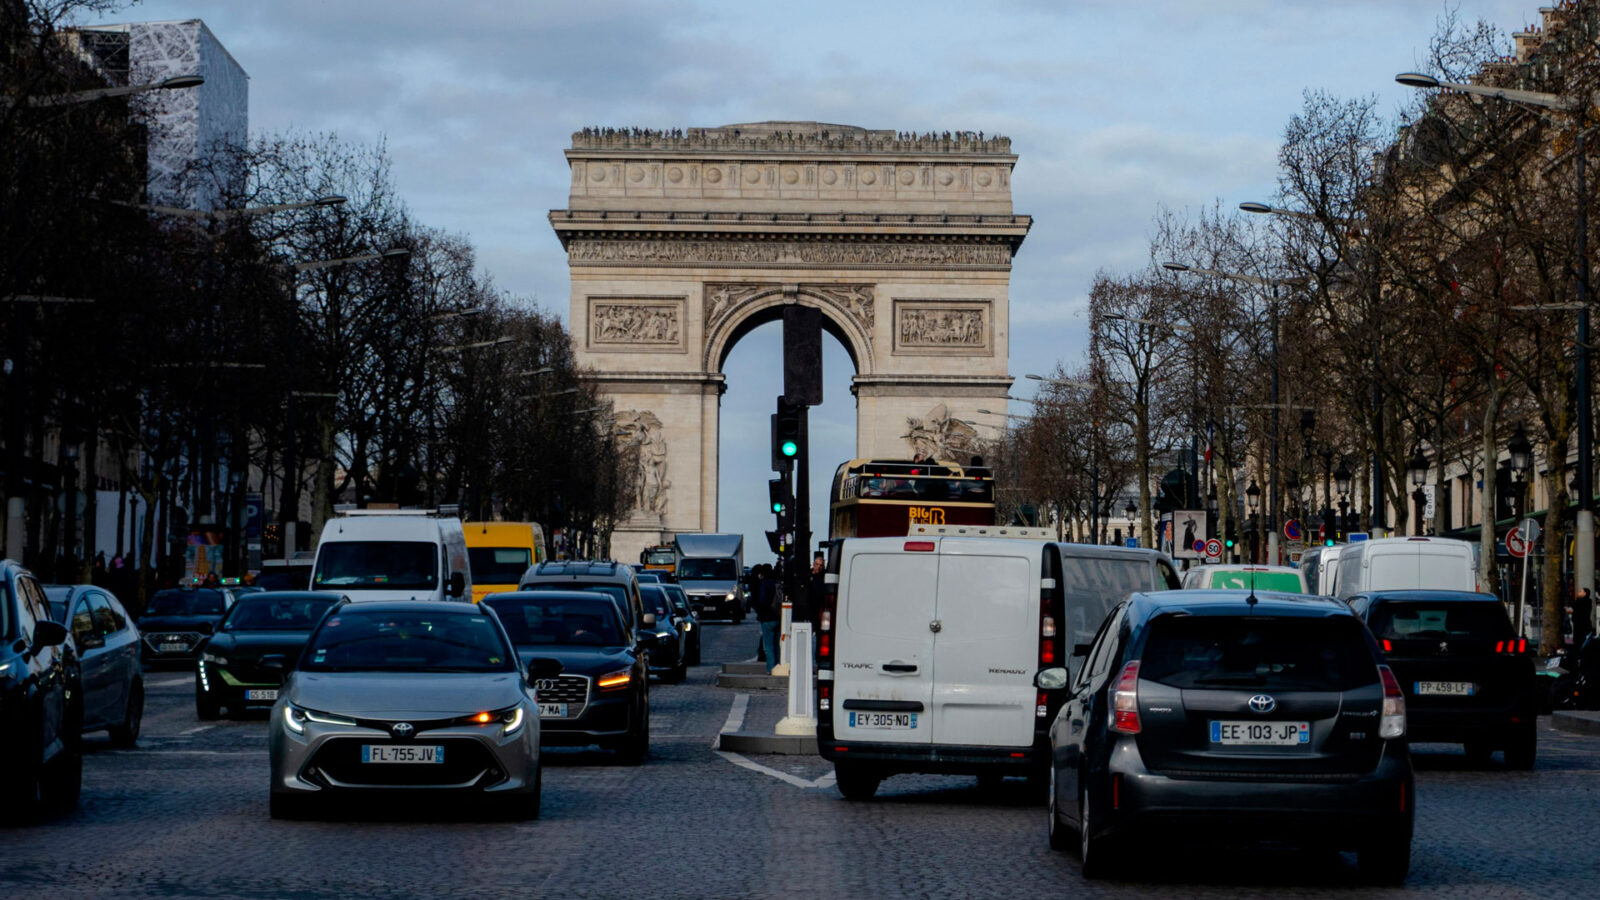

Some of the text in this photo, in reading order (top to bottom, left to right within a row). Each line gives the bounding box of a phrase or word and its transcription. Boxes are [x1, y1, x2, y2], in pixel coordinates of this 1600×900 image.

[909, 507, 930, 519] BIG
[1208, 544, 1219, 553] 50
[1221, 725, 1298, 740] EE-103-JP
[372, 748, 434, 761] FL-755-JV
